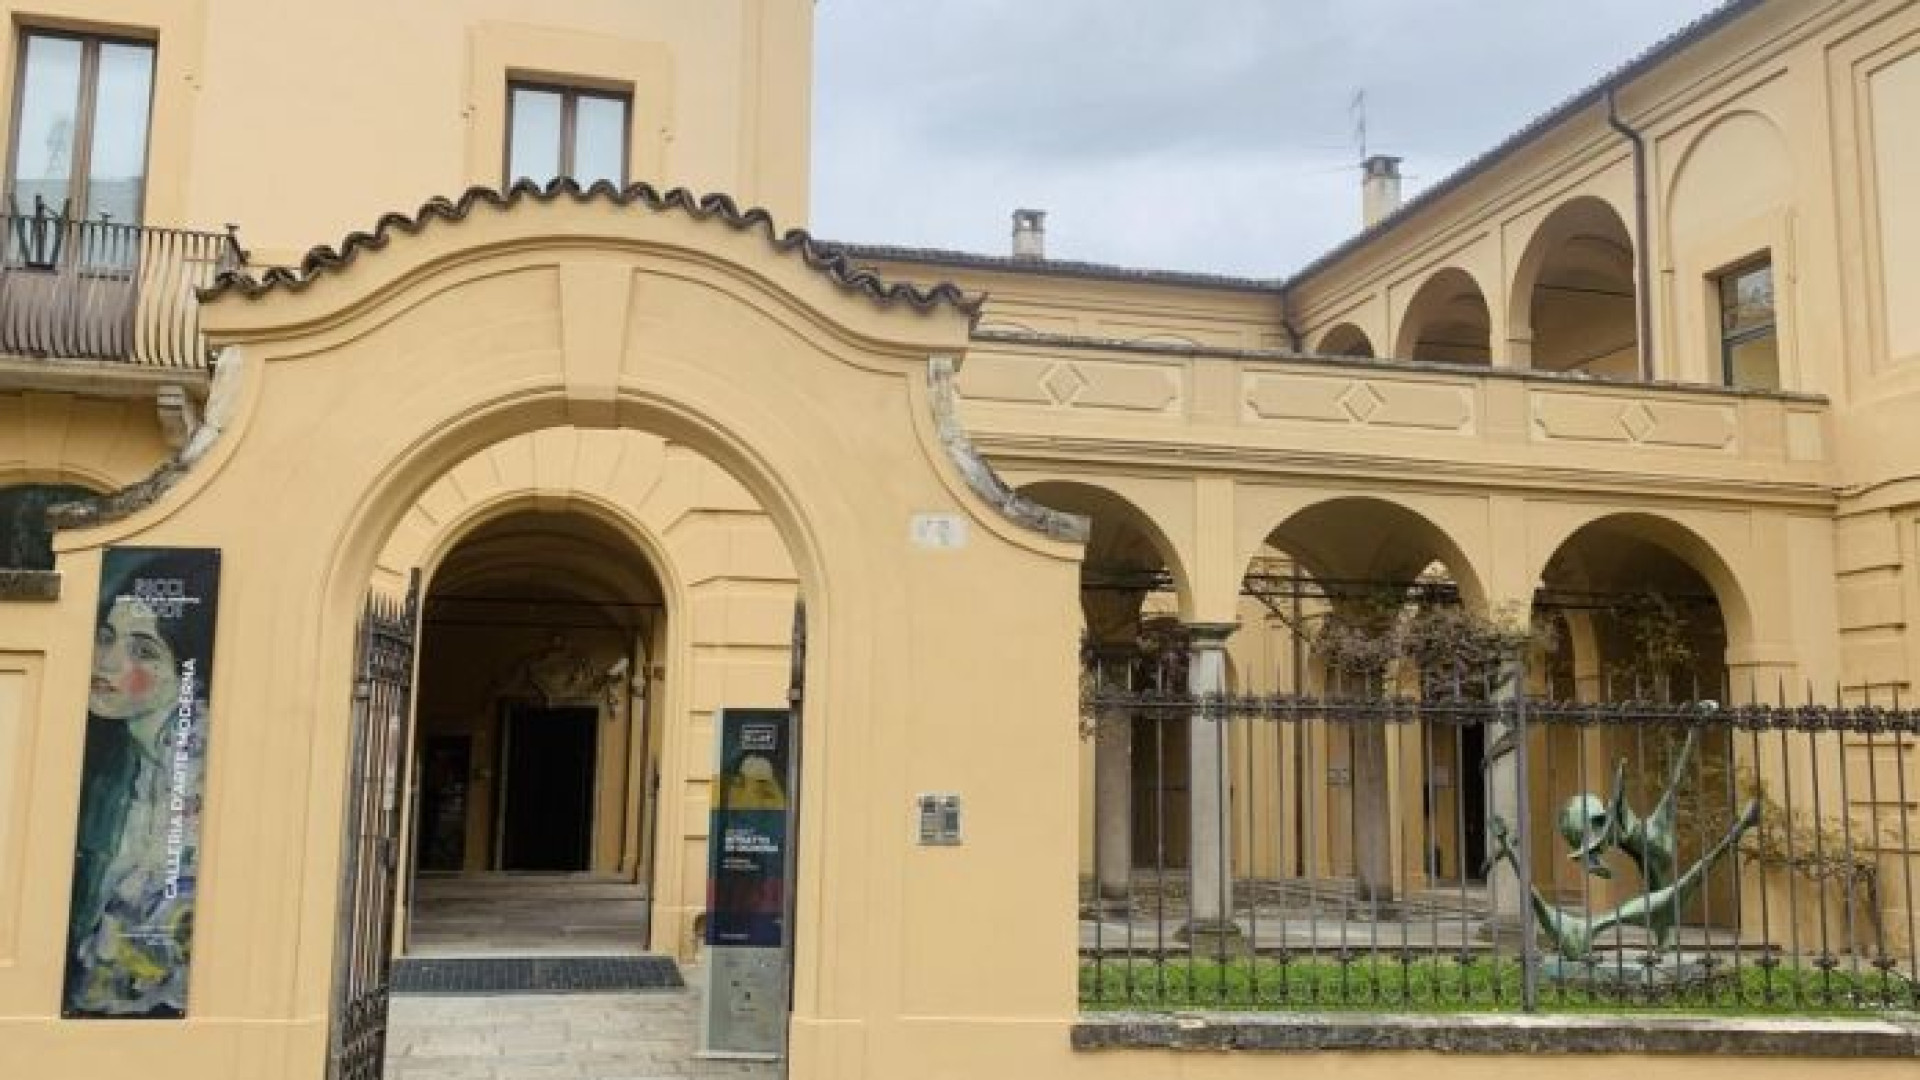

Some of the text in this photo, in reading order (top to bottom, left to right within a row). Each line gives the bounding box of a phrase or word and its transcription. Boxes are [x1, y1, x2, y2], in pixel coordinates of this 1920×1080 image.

[165, 657, 197, 899] GALLERIA D'ARTE MODERNA
